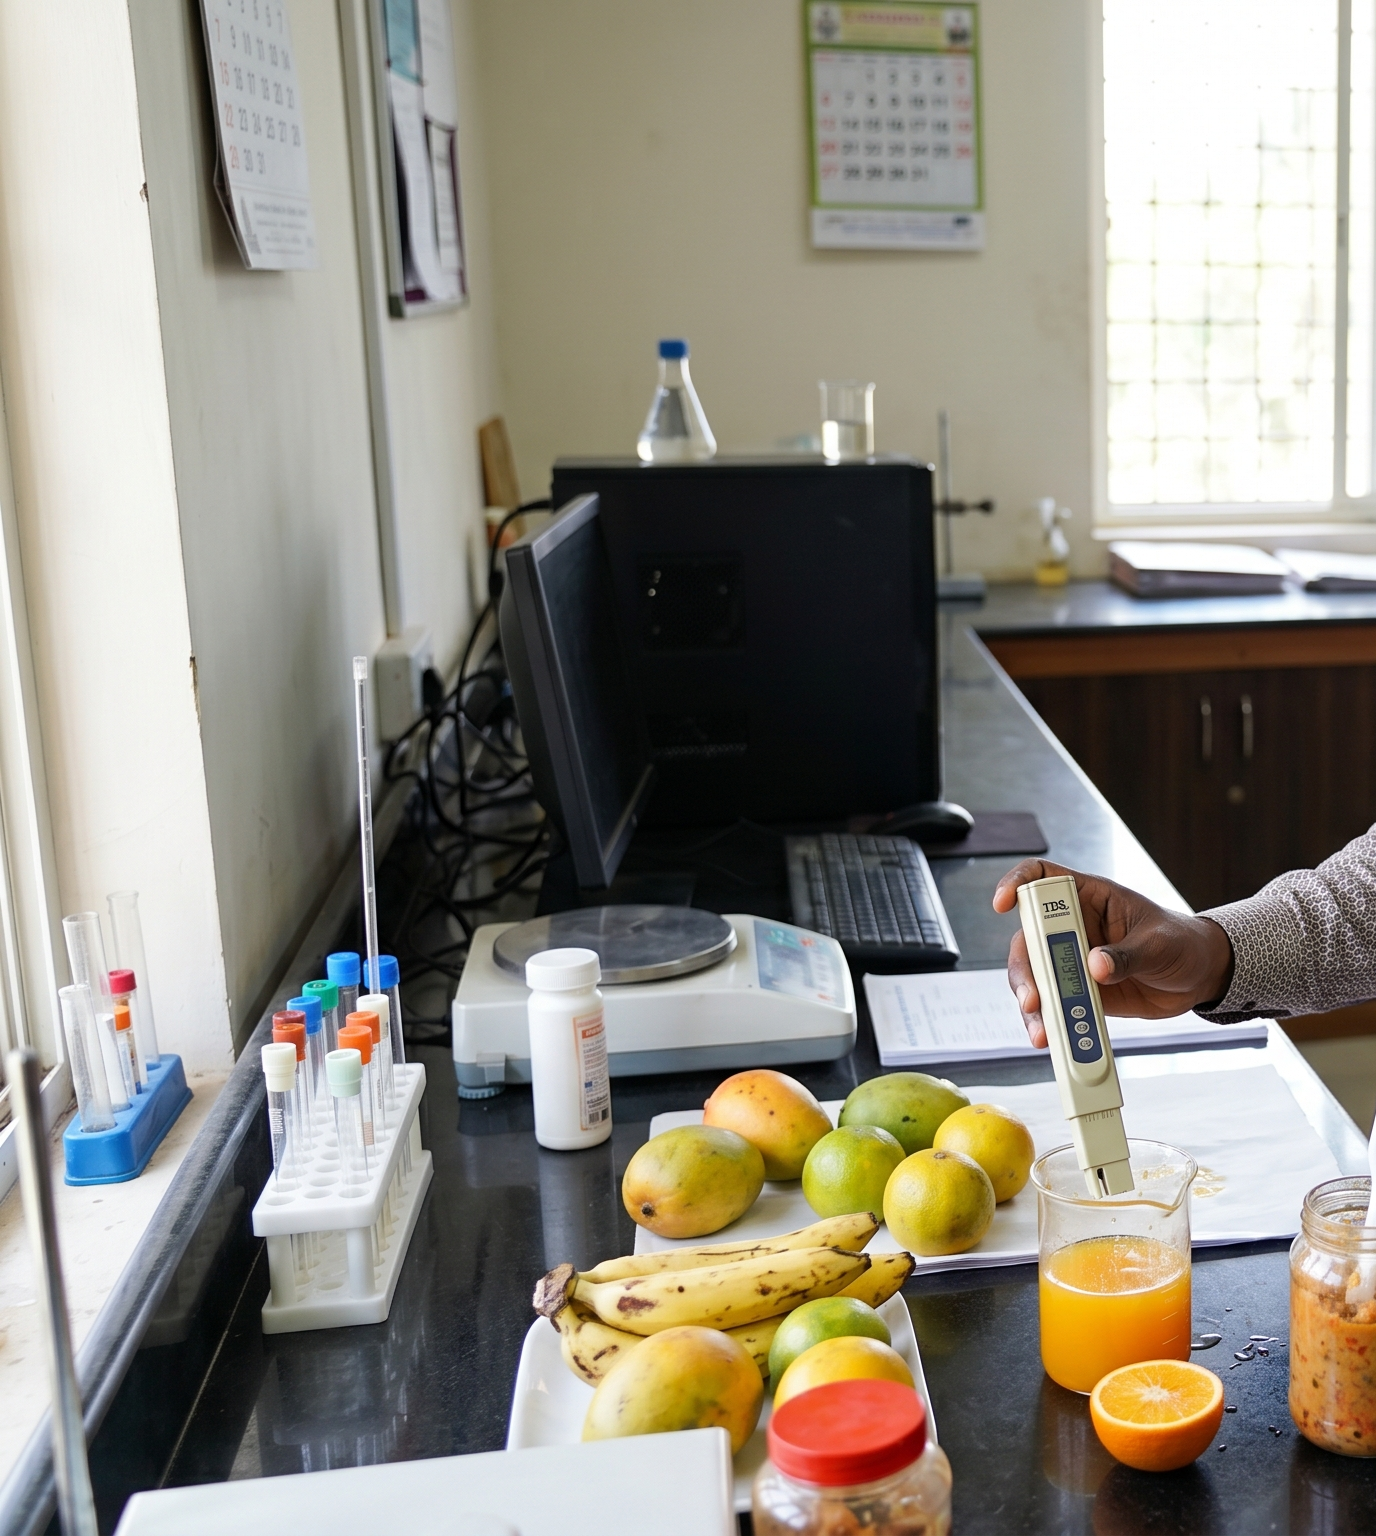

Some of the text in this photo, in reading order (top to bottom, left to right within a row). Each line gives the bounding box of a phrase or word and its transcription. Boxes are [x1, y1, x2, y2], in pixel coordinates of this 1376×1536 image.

[215, 18, 221, 43] 7
[230, 25, 236, 49] 9
[224, 102, 234, 128] 22
